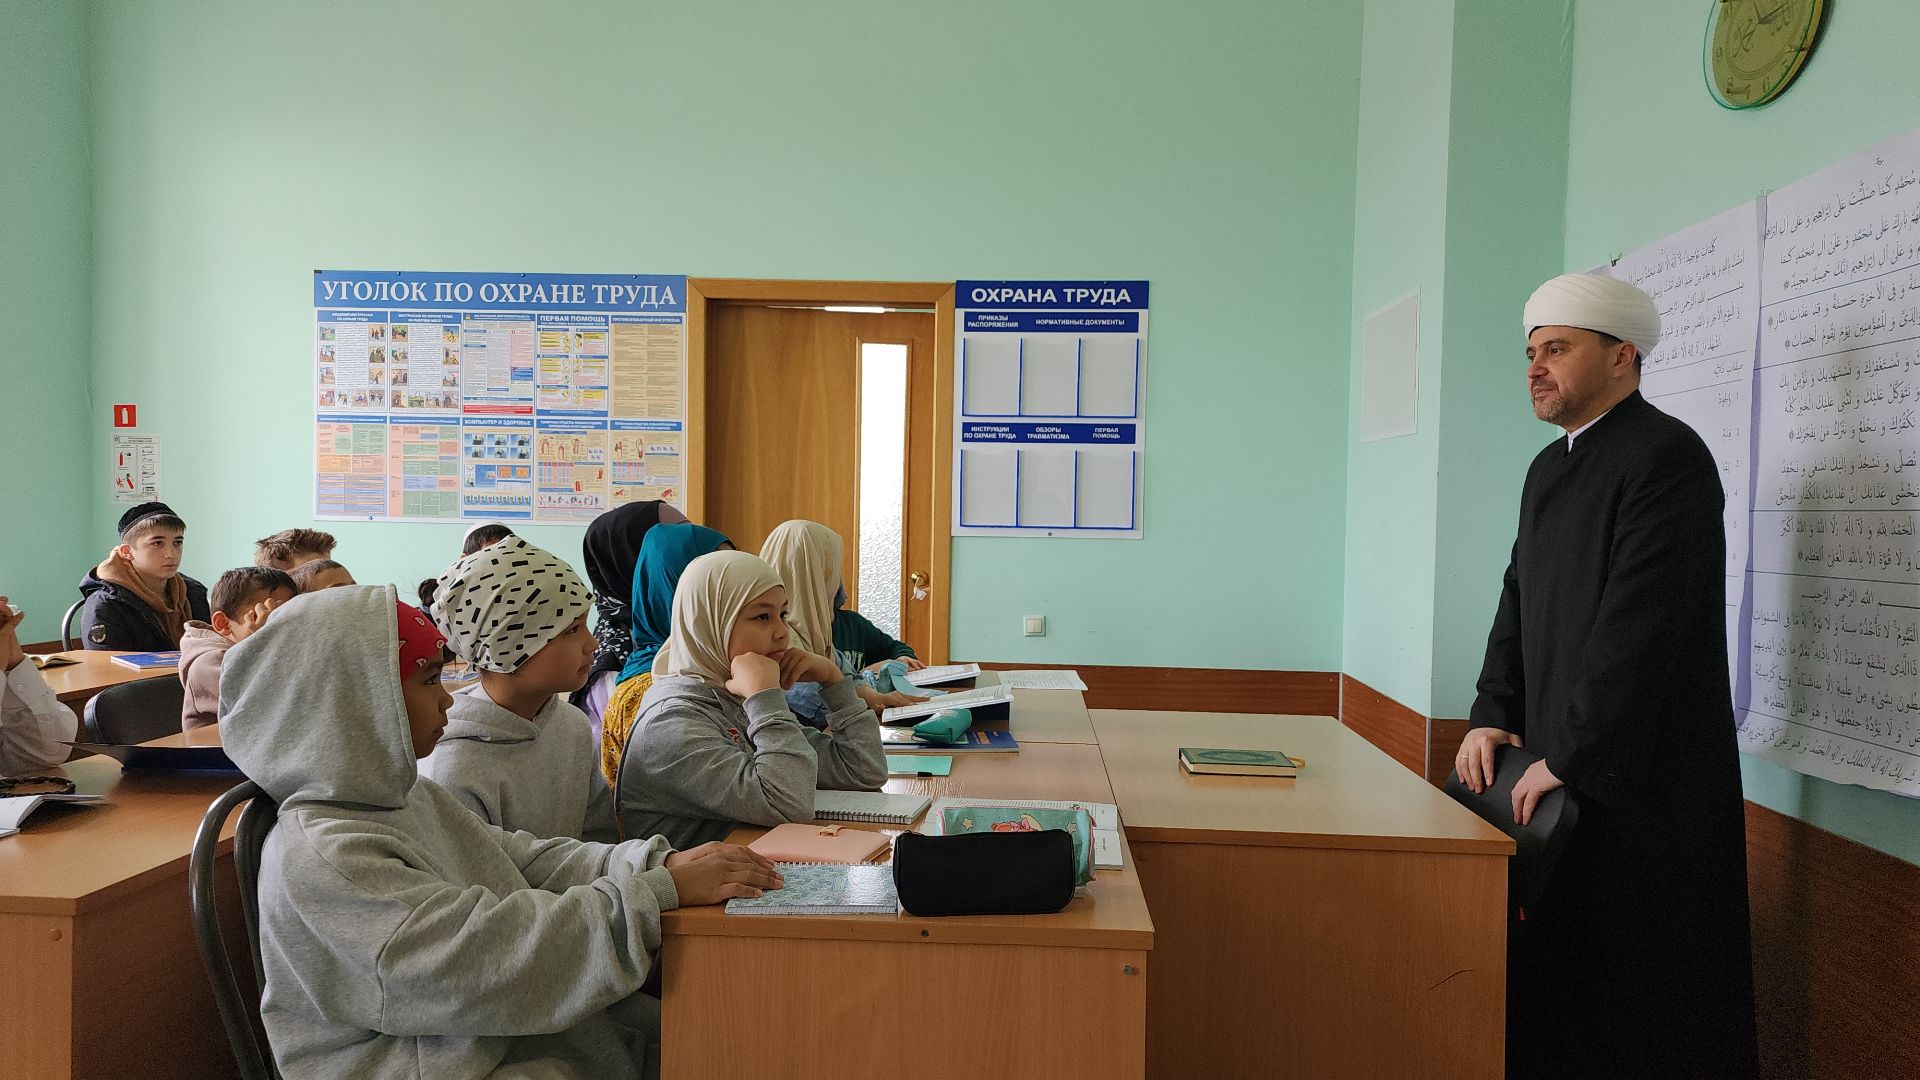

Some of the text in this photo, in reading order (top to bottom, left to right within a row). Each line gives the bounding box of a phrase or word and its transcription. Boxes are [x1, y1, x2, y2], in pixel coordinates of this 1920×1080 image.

[321, 280, 678, 309] УГОЛОК ПО ОХРАНЕ ТРУДА
[971, 288, 1131, 305] ОХРАНА ТРУДА
[570, 315, 606, 323] ПОМОЩЬ
[1035, 318, 1125, 327] НОРМАТИВНЫЕ ДОКУМЕНТЫ
